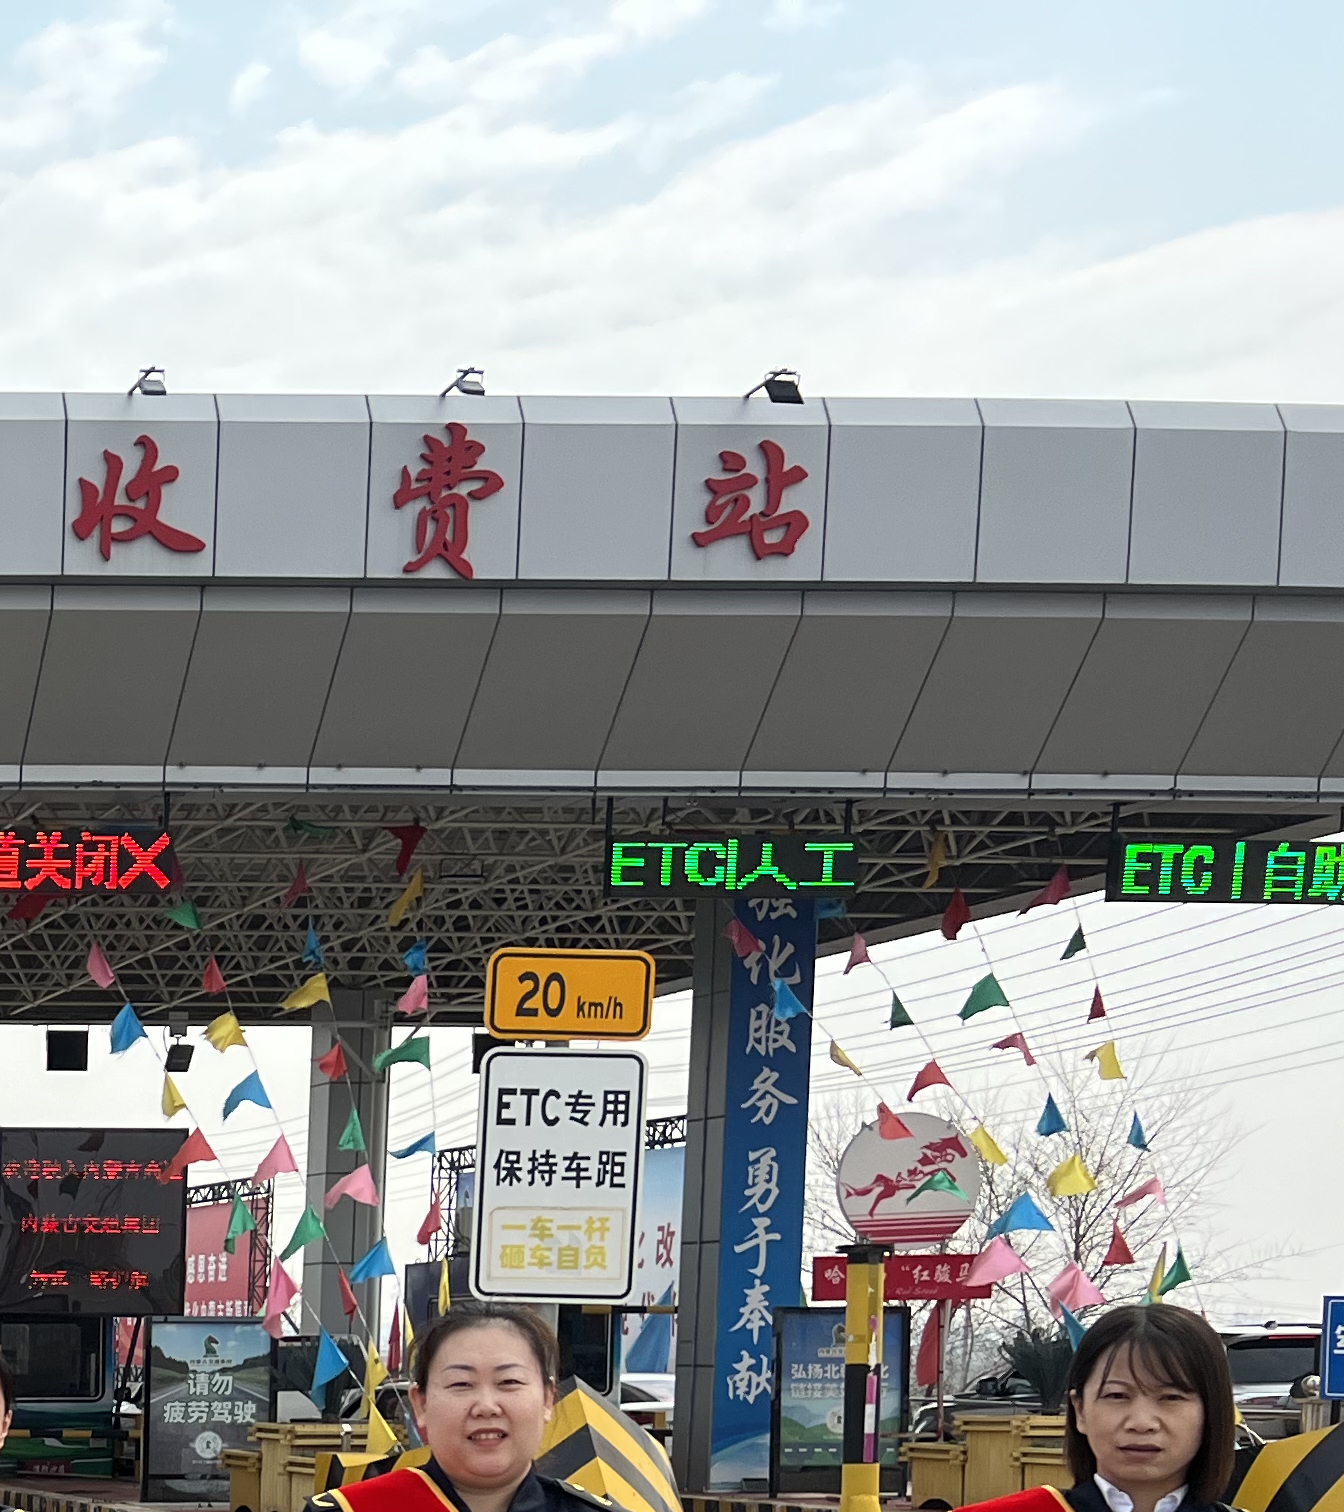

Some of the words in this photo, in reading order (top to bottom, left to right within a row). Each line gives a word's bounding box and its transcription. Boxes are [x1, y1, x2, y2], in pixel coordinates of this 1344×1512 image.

[515, 971, 566, 1018] 20
[576, 996, 623, 1020] km/h
[496, 1088, 631, 1127] ETC专用
[493, 1149, 627, 1188] 保持车距
[500, 1216, 610, 1242] 一车一杆
[499, 1244, 608, 1270] 砸车自负
[727, 1147, 782, 1404] 勇于奉献
[188, 1373, 233, 1396] 请勿
[163, 1401, 256, 1424] 疲劳驾驶
